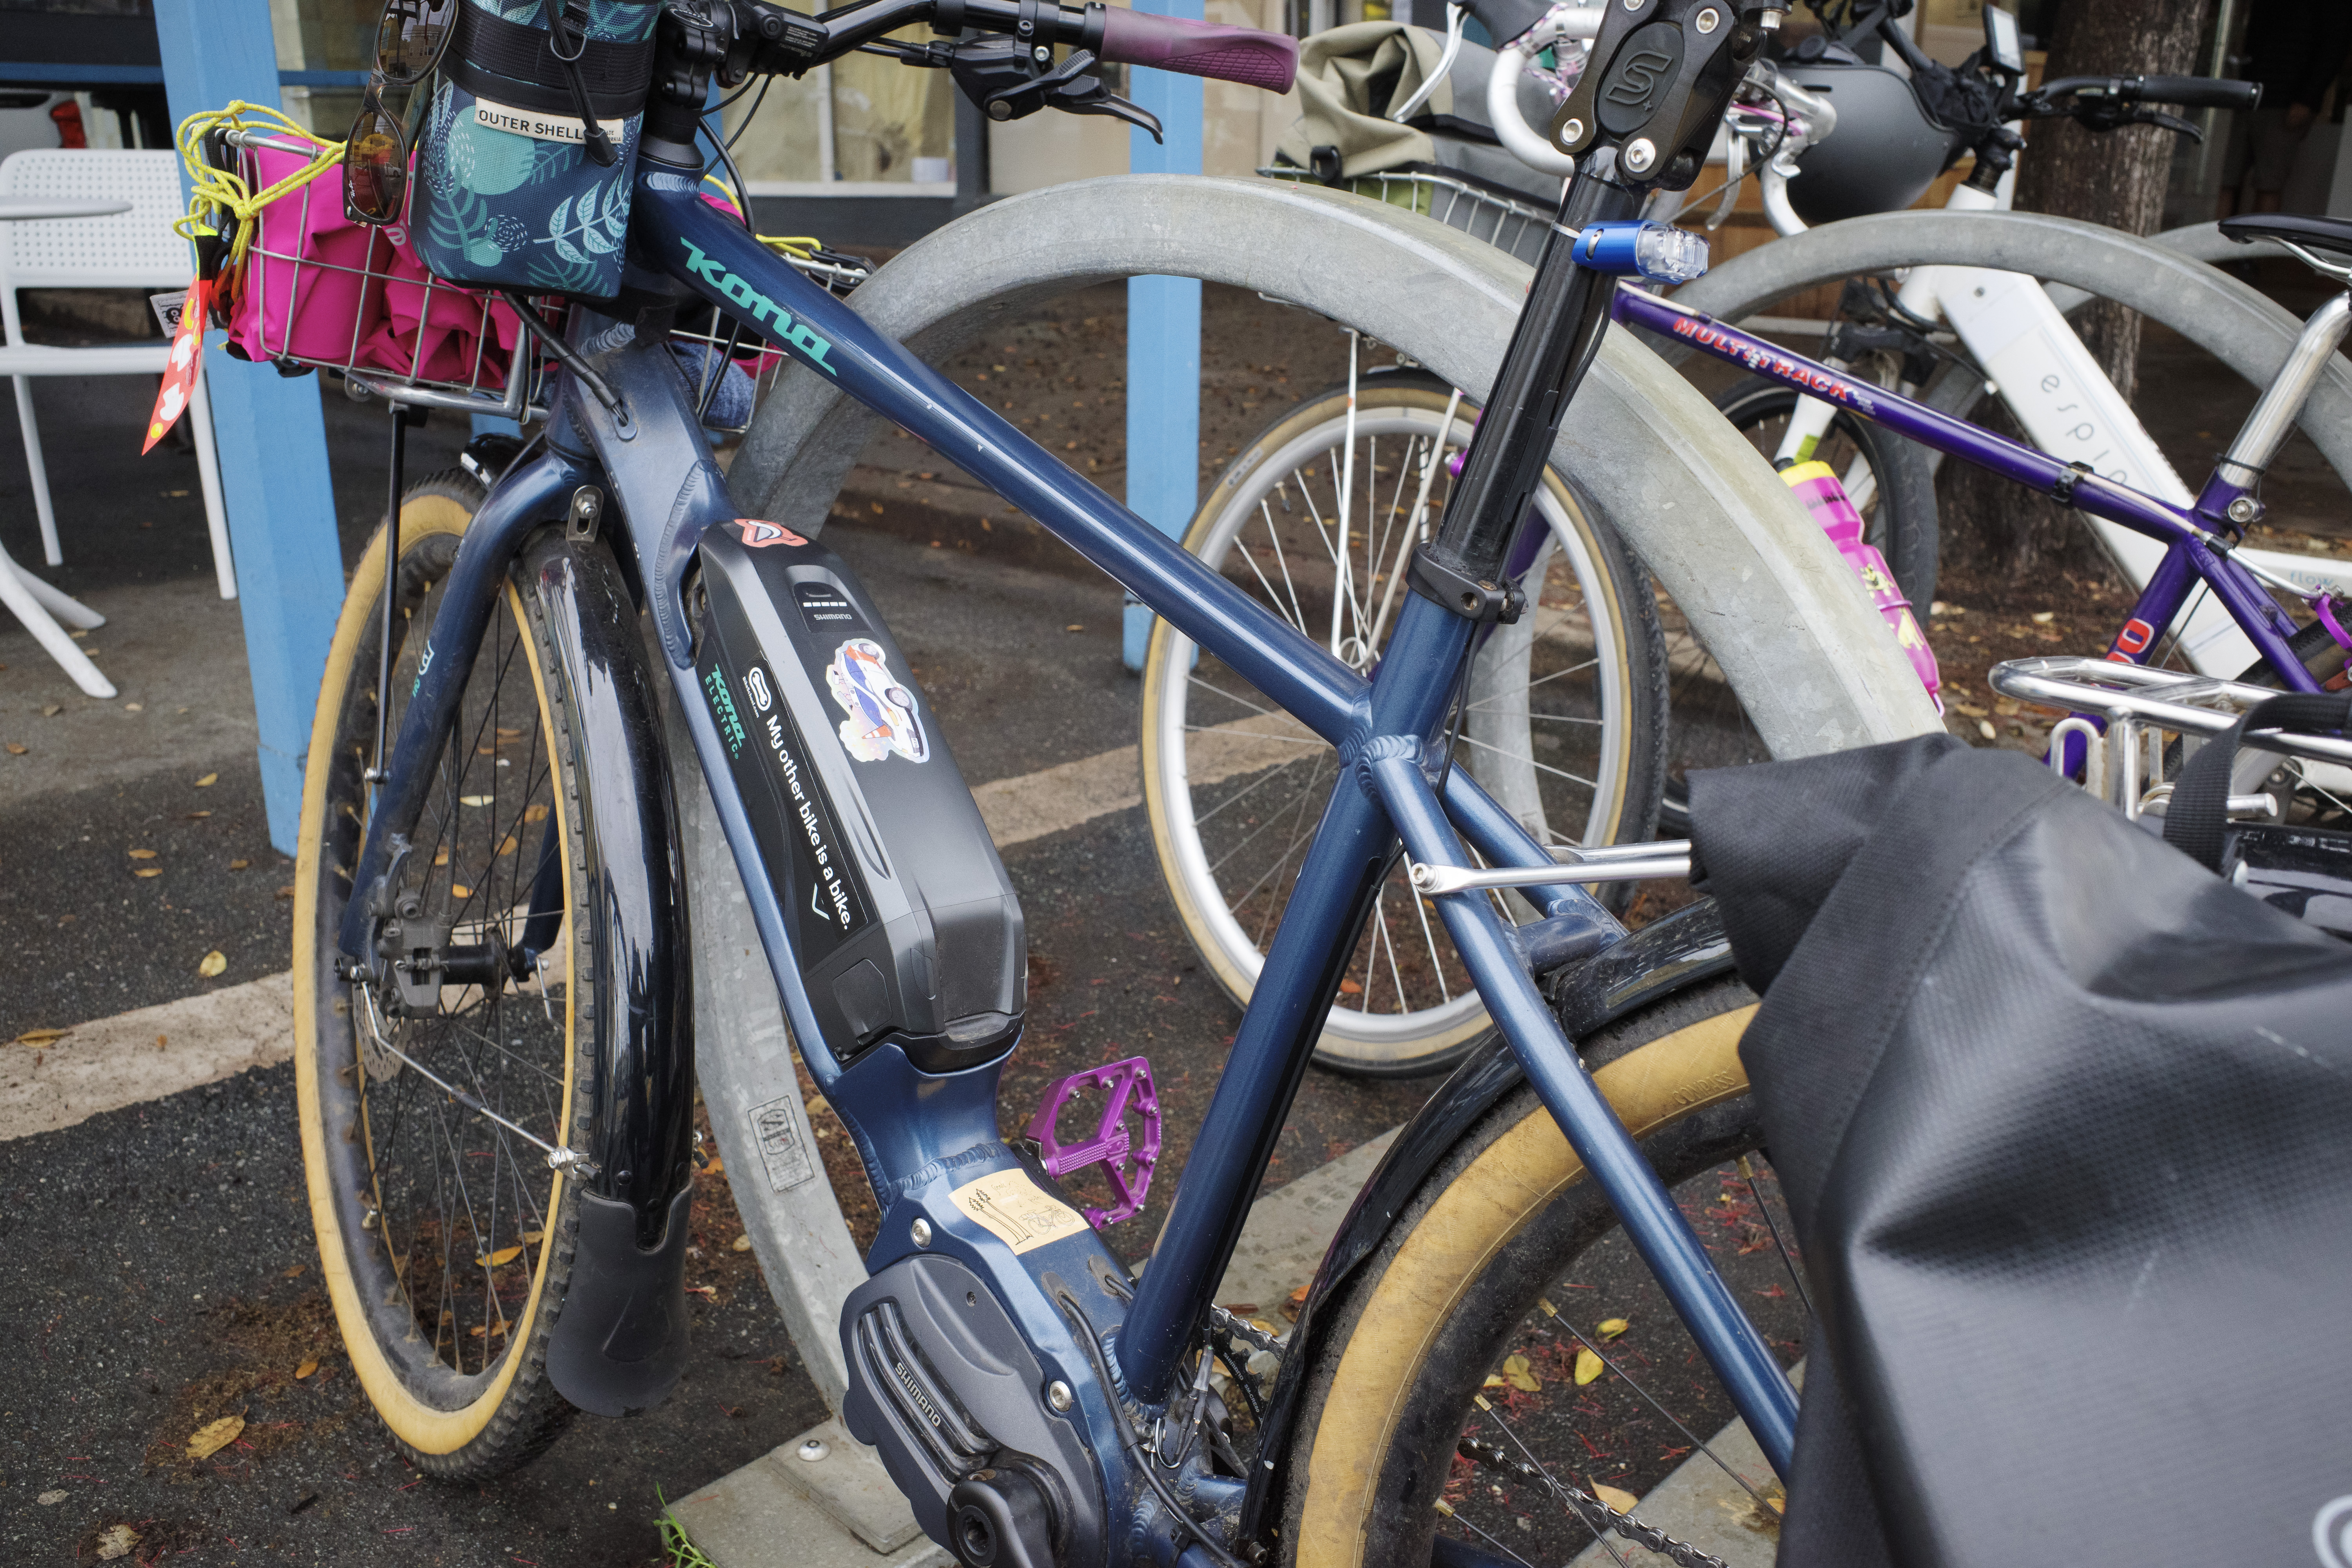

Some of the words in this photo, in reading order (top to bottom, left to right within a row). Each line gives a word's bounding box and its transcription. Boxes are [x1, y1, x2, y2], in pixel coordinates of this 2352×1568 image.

[479, 110, 530, 132] OUTER
[534, 123, 583, 140] SHELL
[2290, 570, 2333, 586] flow
[742, 676, 760, 718] BikeSchool.com
[766, 714, 784, 749] My
[779, 750, 805, 801] other
[799, 800, 820, 846] bike
[815, 844, 828, 865] is
[823, 866, 833, 881] a
[829, 879, 850, 930] bike.
[1673, 1071, 1735, 1104] COMPASS
[1223, 1352, 1244, 1381] SHIMANO
[895, 1362, 941, 1427] SHIMANO
